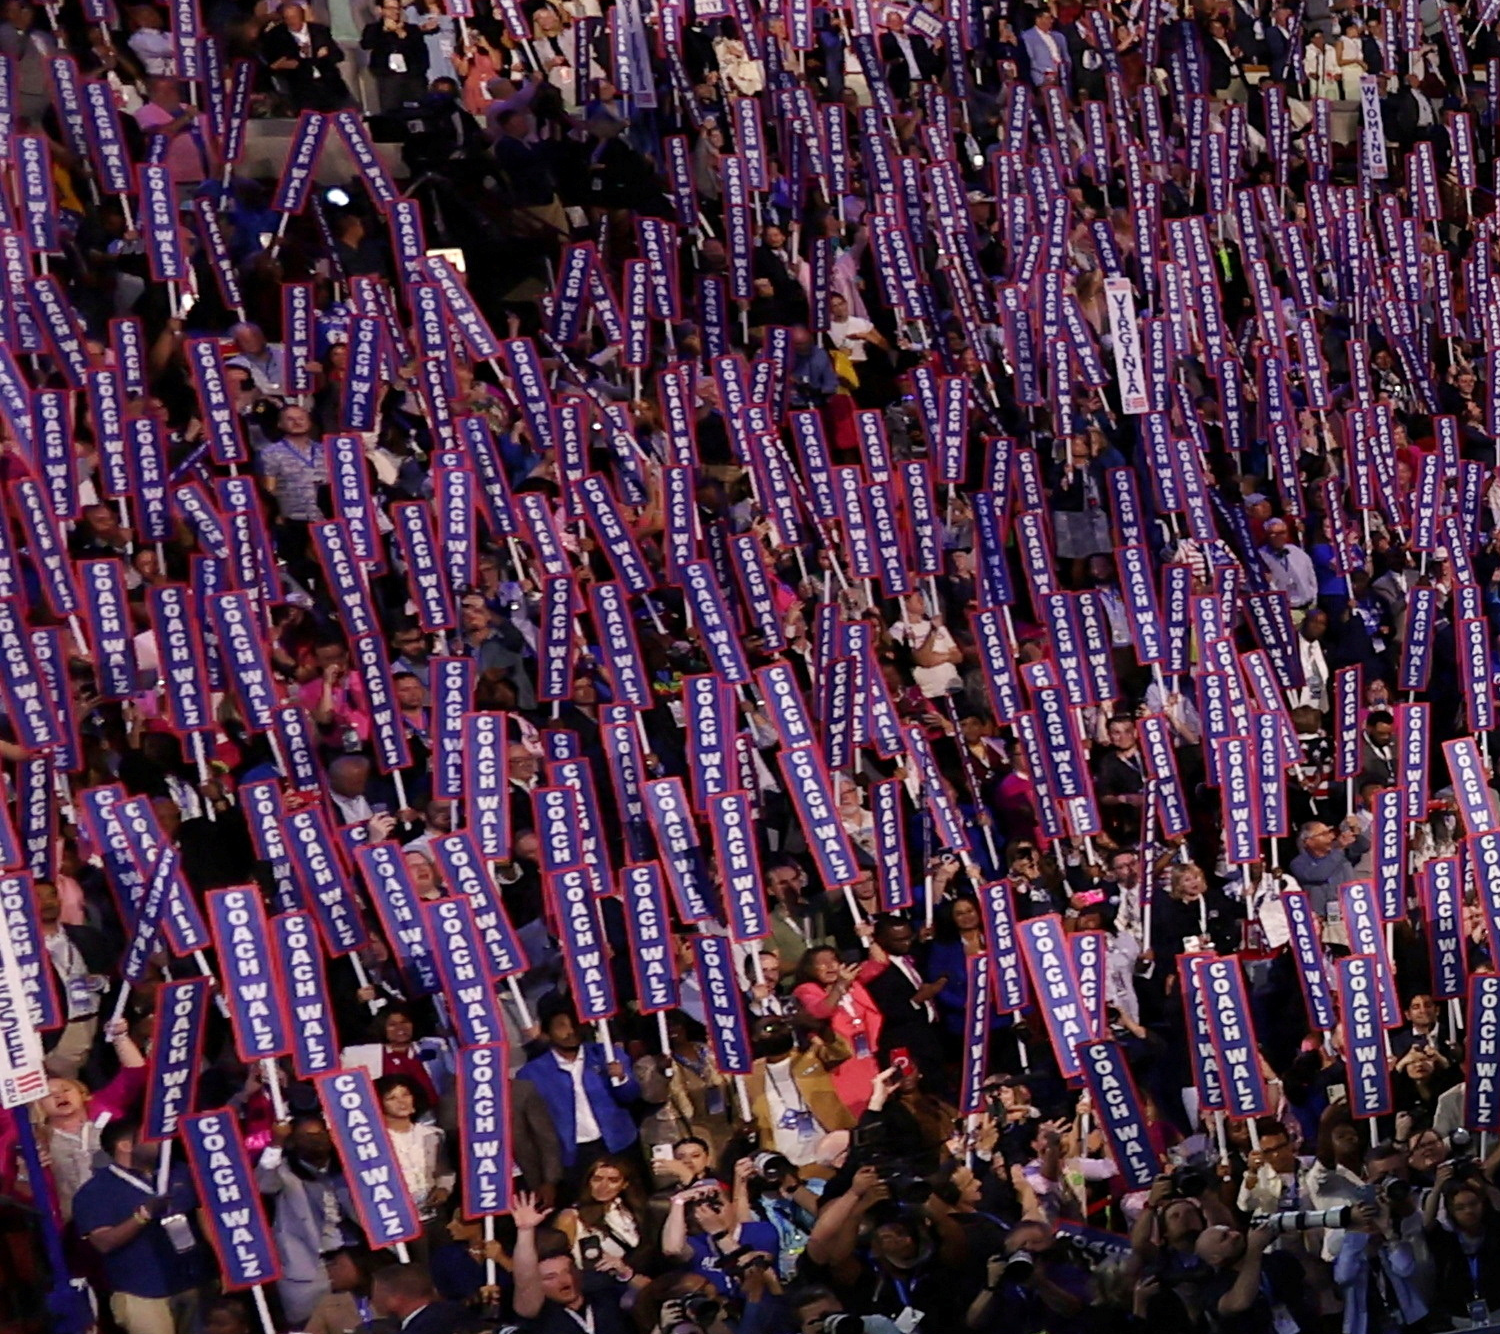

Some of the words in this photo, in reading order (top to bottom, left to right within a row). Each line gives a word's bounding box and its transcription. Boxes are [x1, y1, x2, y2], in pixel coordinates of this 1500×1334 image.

[1362, 87, 1382, 164] WYOMING
[1113, 294, 1141, 395] VIRGINIA
[473, 1049, 496, 1133] COACH
[198, 1115, 240, 1204] COACH
[221, 1208, 263, 1279] WALZ
[473, 1140, 499, 1209] WALZ
